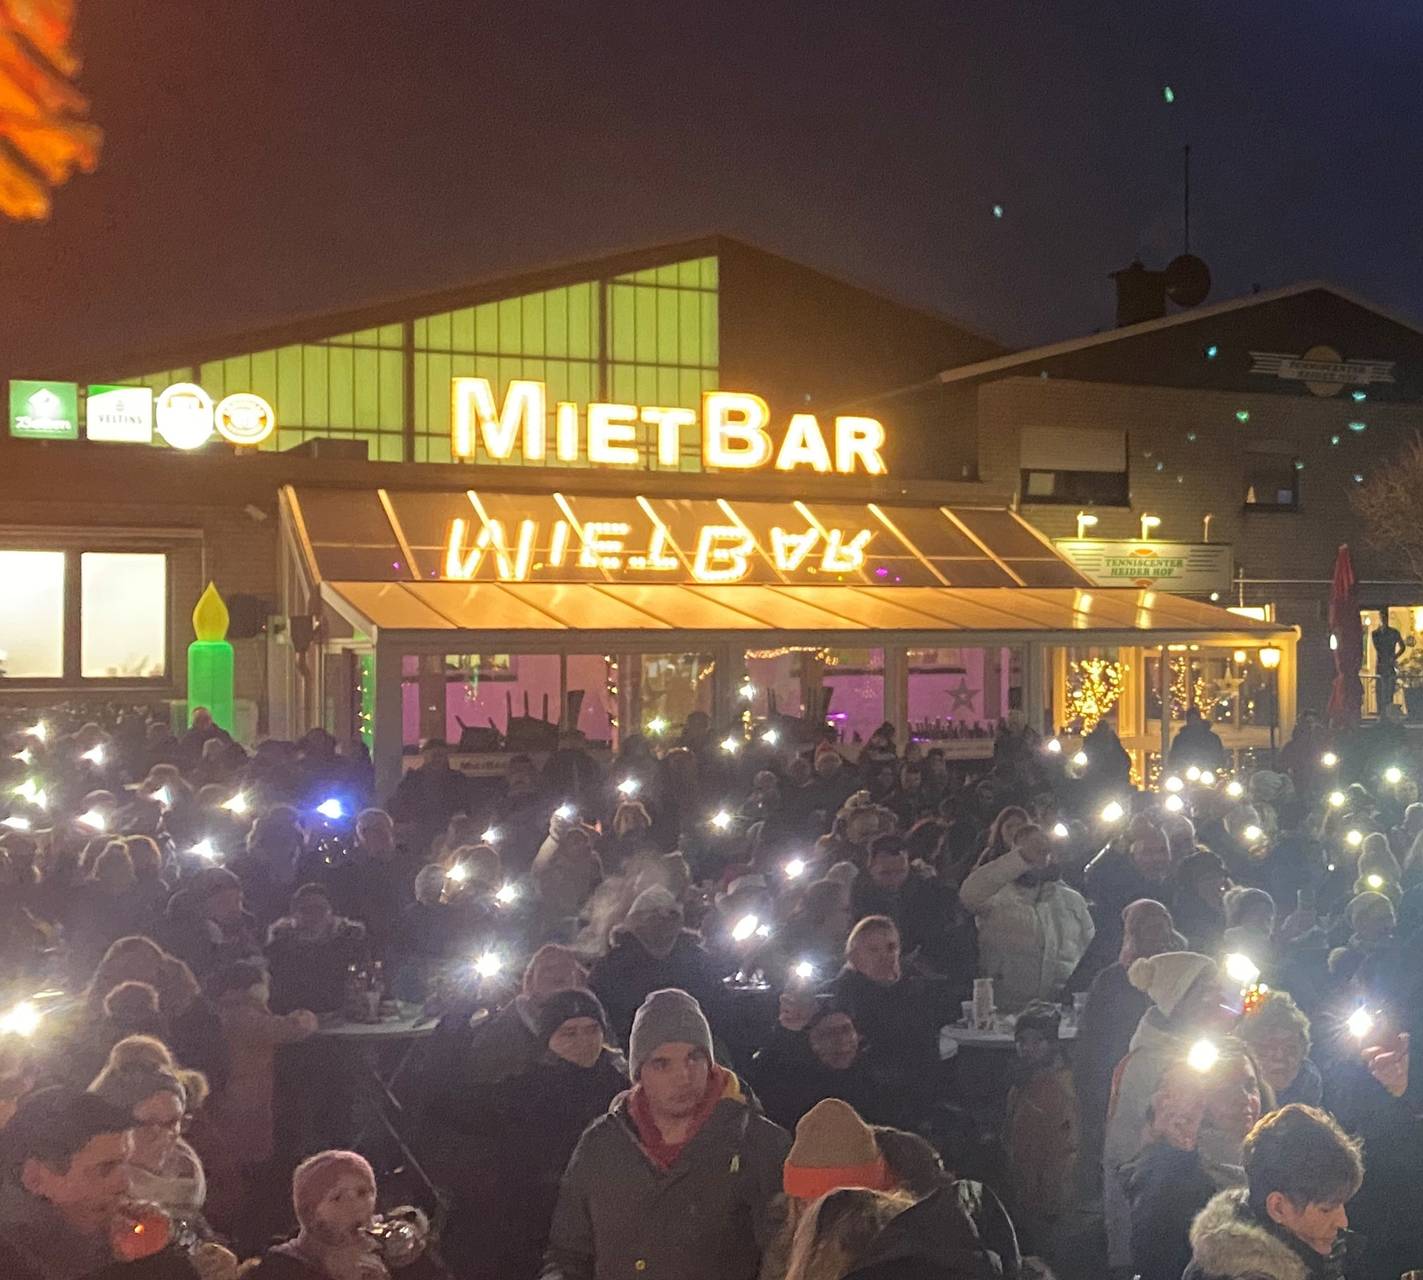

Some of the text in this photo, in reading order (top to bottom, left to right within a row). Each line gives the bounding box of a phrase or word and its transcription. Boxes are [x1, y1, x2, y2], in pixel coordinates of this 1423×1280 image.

[99, 415, 142, 424] VELTINS
[1105, 559, 1184, 568] TENNISCENTER
[1111, 568, 1174, 576] HEIDER HOF
